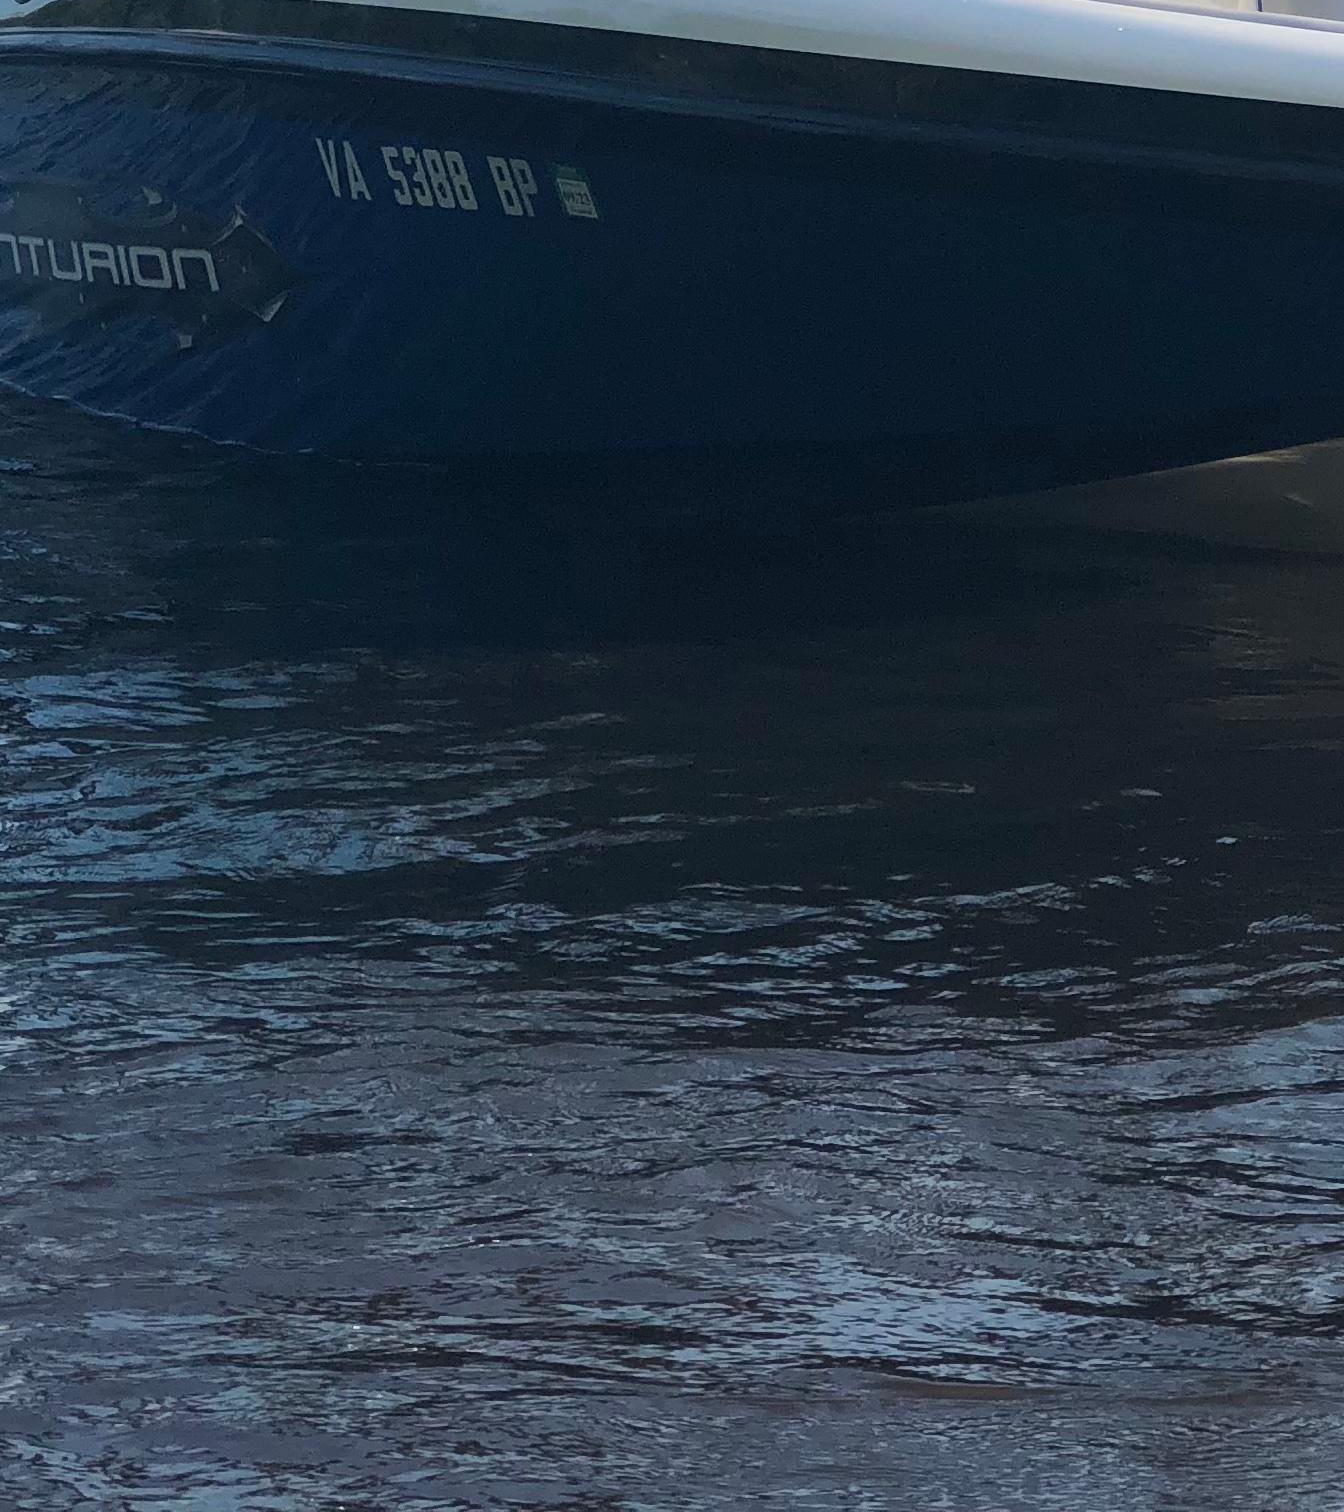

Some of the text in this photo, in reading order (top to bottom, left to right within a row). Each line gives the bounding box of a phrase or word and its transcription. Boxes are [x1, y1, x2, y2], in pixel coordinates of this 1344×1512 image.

[315, 138, 538, 217] VA 5388 BP
